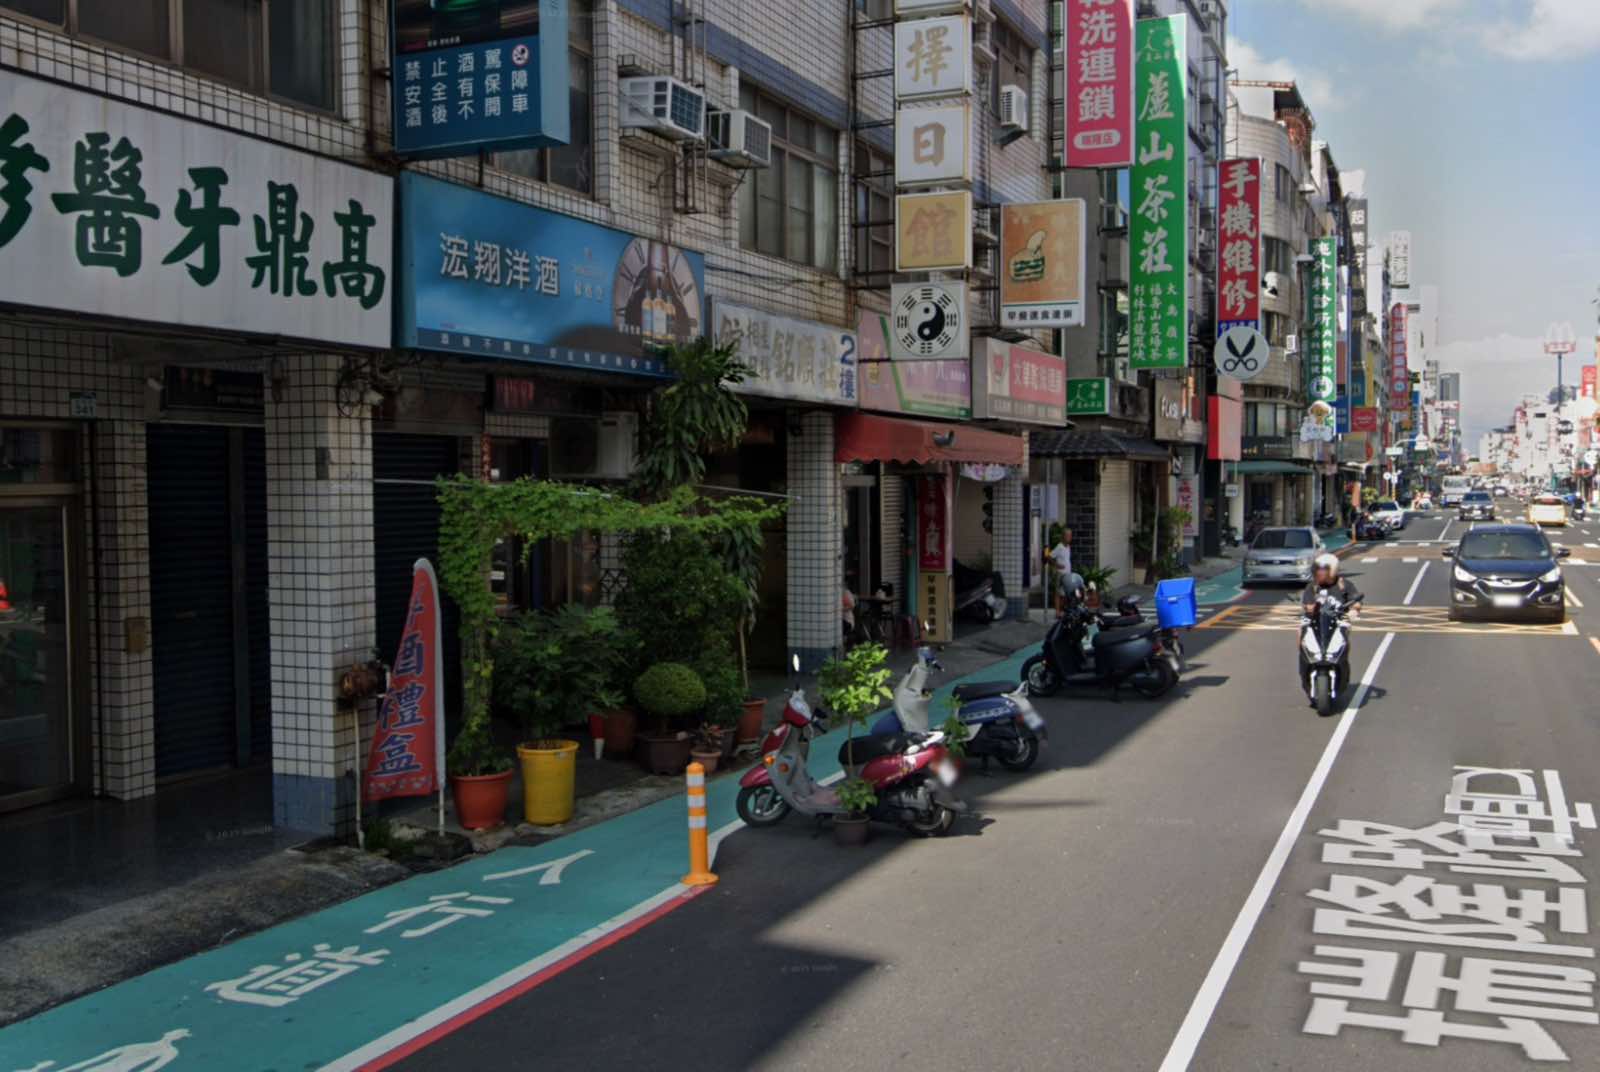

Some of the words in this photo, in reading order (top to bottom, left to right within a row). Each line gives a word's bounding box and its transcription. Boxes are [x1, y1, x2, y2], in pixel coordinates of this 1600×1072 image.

[1078, 0, 1117, 122] 洗連鎖
[905, 25, 957, 259] 擇日館
[1220, 162, 1257, 317] 手機維修
